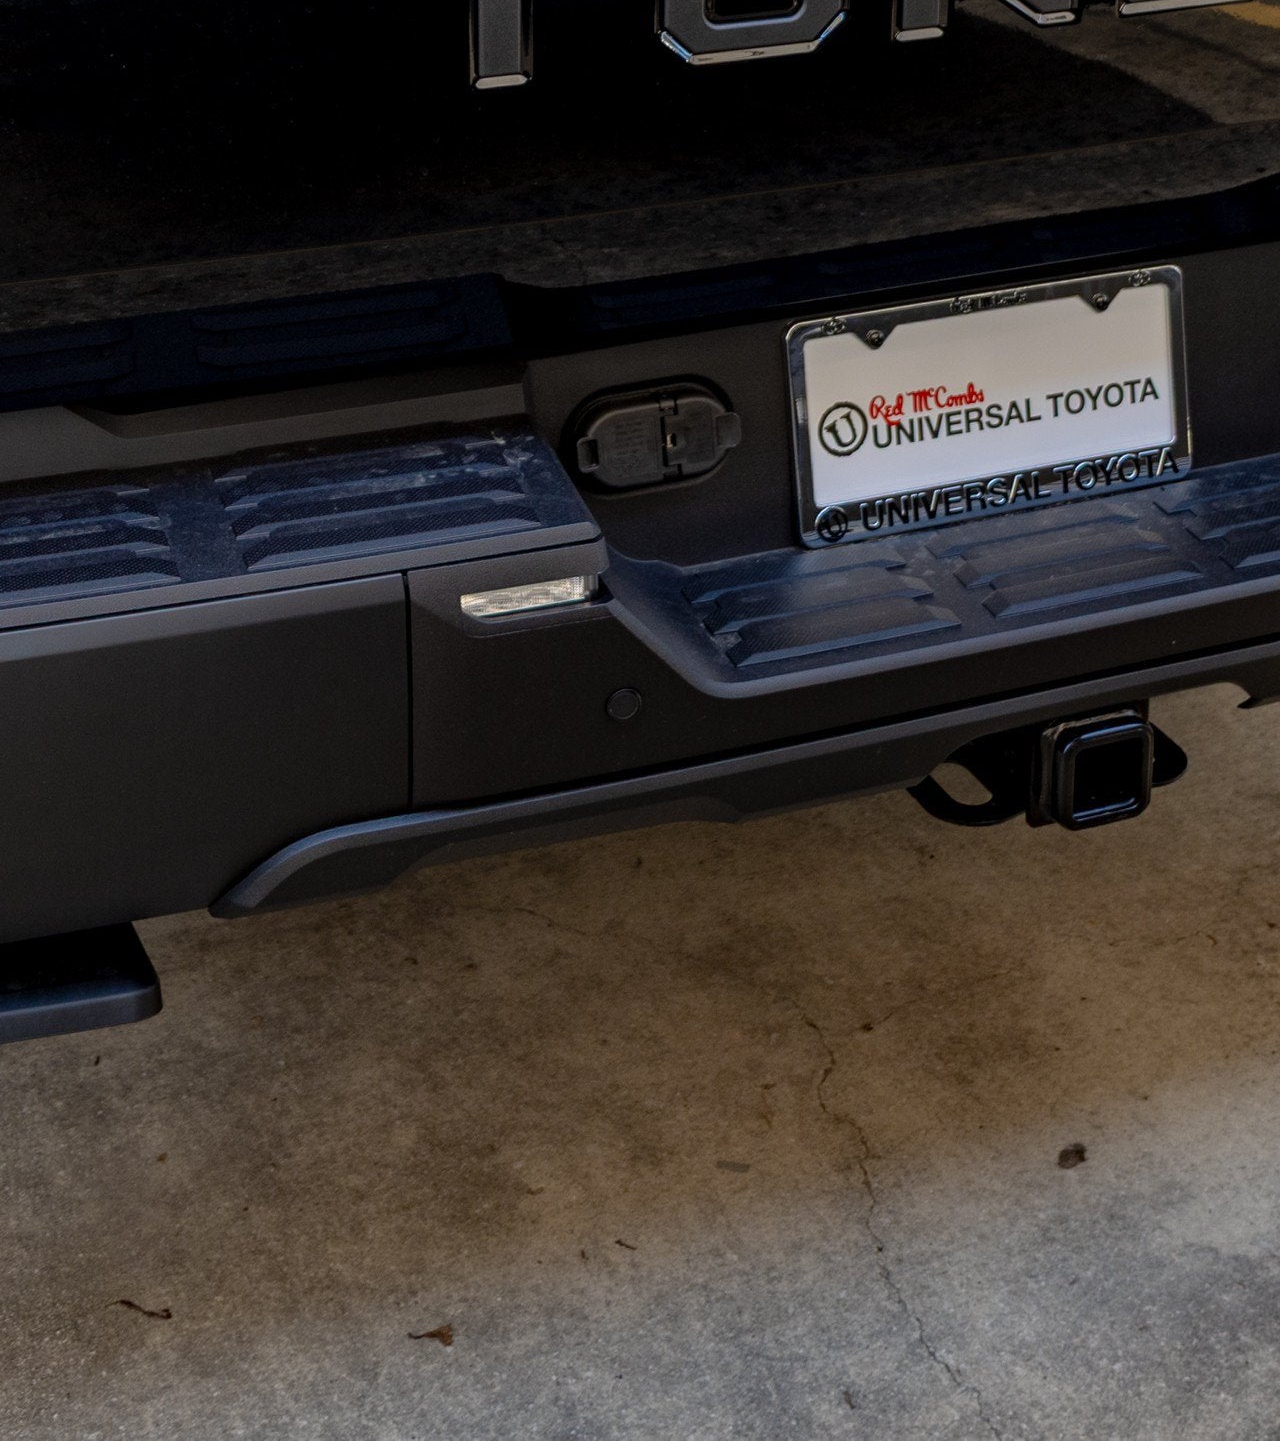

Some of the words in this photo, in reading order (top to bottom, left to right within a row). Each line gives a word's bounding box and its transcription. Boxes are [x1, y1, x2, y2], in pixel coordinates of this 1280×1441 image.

[869, 395, 904, 426] Red
[907, 383, 985, 414] McCombs
[871, 398, 1042, 449] UNIVERSAL
[1045, 377, 1160, 419] TOYOTA
[859, 469, 1053, 531] UNIVERSAL
[1052, 447, 1181, 494] TOYOTA
